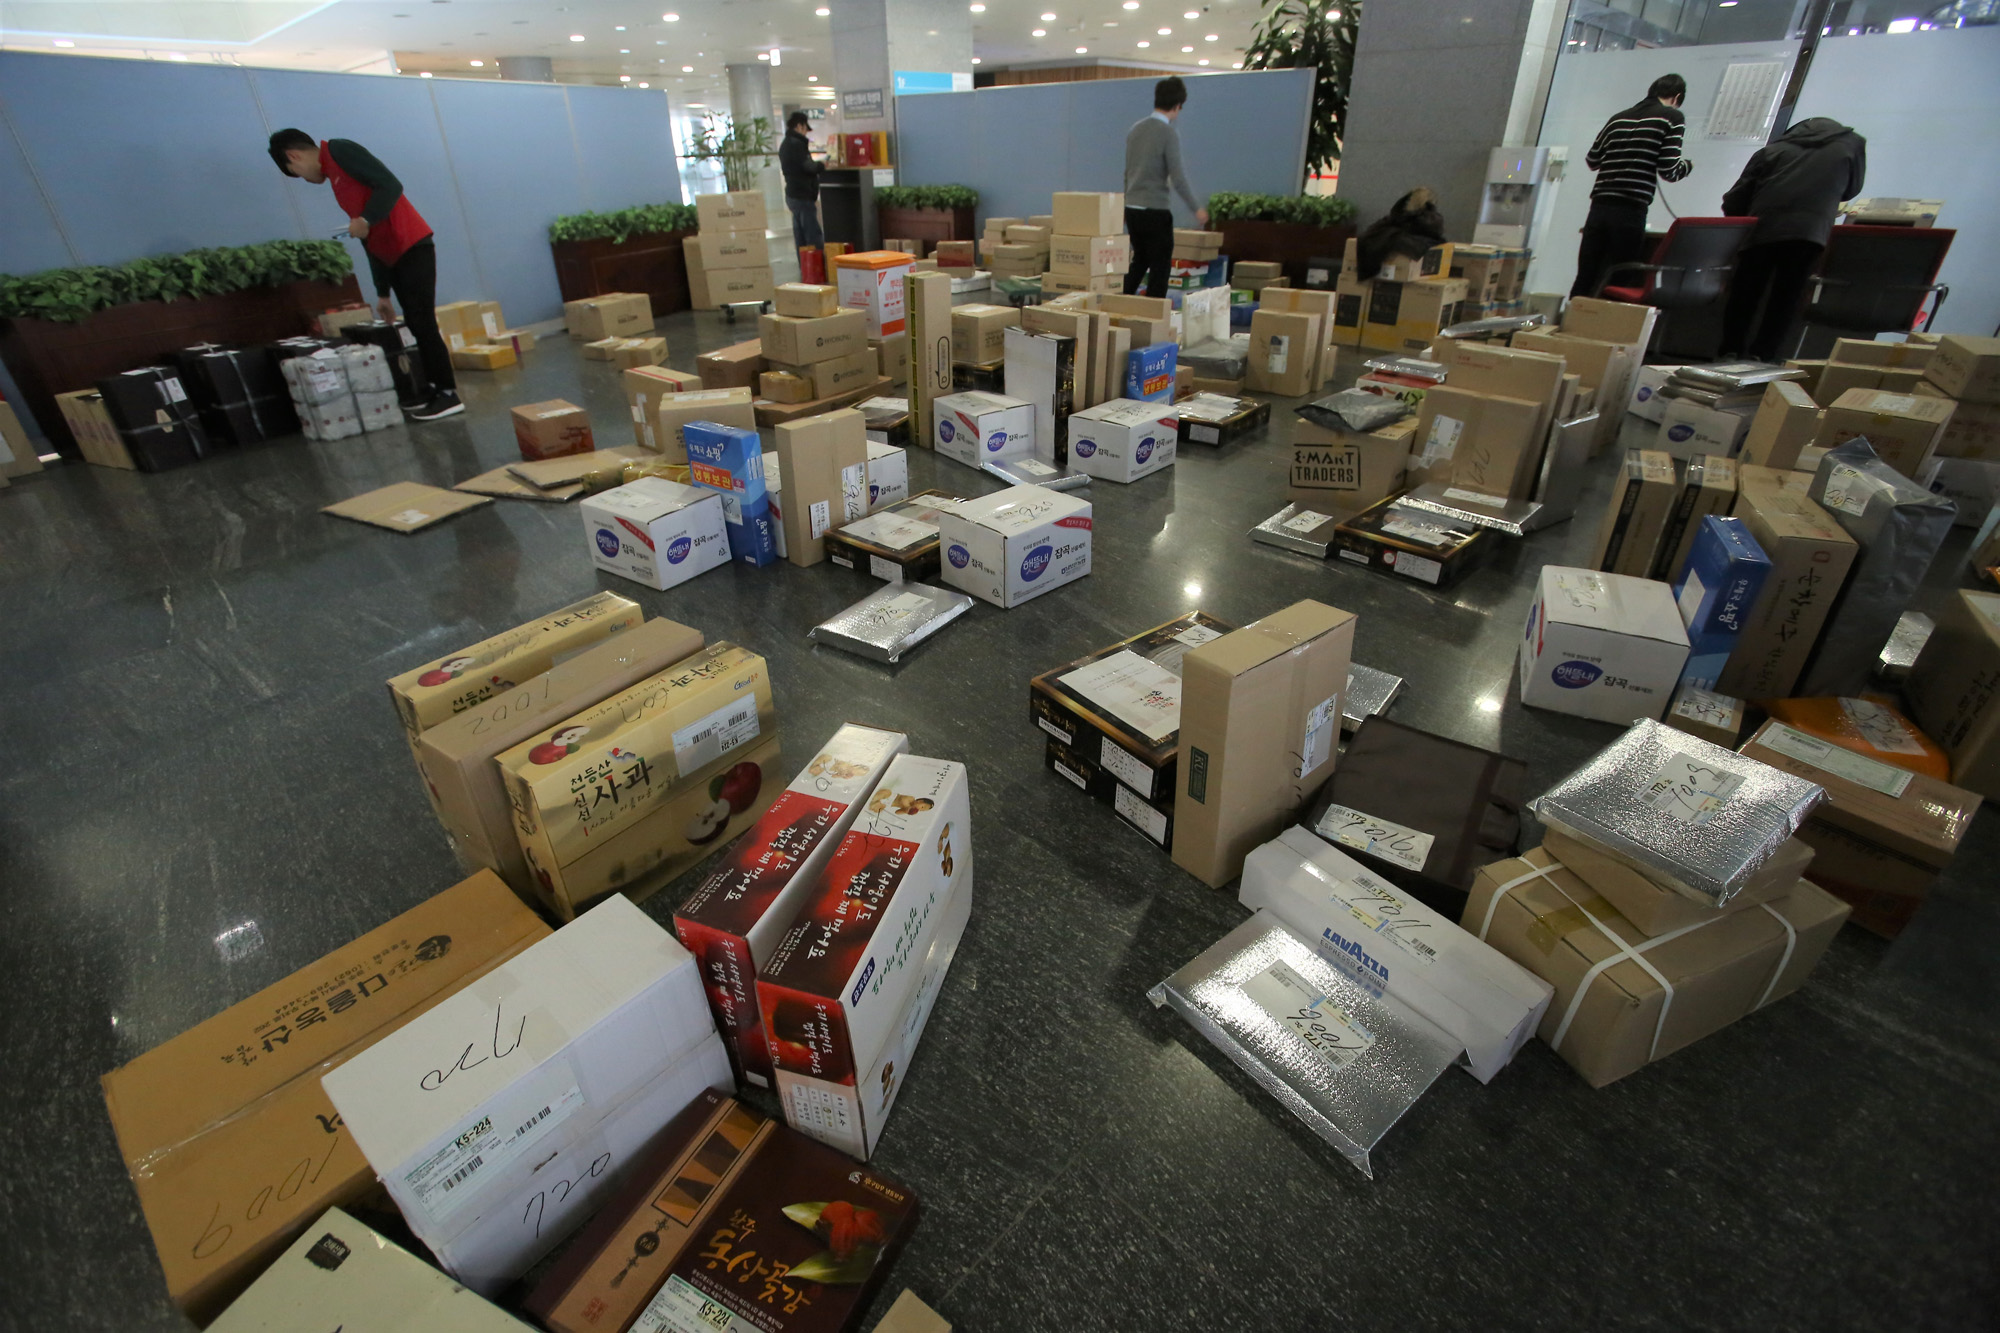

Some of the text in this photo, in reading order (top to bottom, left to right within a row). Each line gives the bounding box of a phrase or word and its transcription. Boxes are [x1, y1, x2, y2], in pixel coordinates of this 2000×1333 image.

[1294, 466, 1354, 482] TRADERS
[1022, 553, 1049, 576] 햇뜰내
[1054, 544, 1070, 560] 잡곡
[1557, 664, 1596, 685] 햇뜰내
[1604, 674, 1629, 690] 잡곡
[452, 686, 494, 714] 천등산
[570, 759, 614, 794] 천등산
[593, 756, 654, 810] 사과
[573, 792, 592, 822] 신선
[774, 804, 840, 871] 우리 서영이도
[1340, 820, 1416, 852] 1016
[724, 826, 798, 902] 껍질 째 먹어요
[887, 844, 910, 870] 우리
[856, 870, 894, 922] 서영이도
[806, 870, 871, 960] 껍질 째 먹어요
[721, 939, 737, 962] 우리
[1320, 938, 1388, 991] ESPRESSO POINT
[1321, 927, 1390, 983] LAVAZZA
[260, 973, 389, 1054] 다올농산
[814, 1003, 834, 1054] 우리 서영이도
[802, 1022, 818, 1046] 껍질
[1286, 1008, 1364, 1053] 1006
[808, 1052, 823, 1074] 먹어요
[454, 1116, 492, 1149] K5-224
[523, 1152, 611, 1239] 720
[700, 1228, 813, 1314] 동상곶감
[698, 1299, 732, 1328] K5-224
